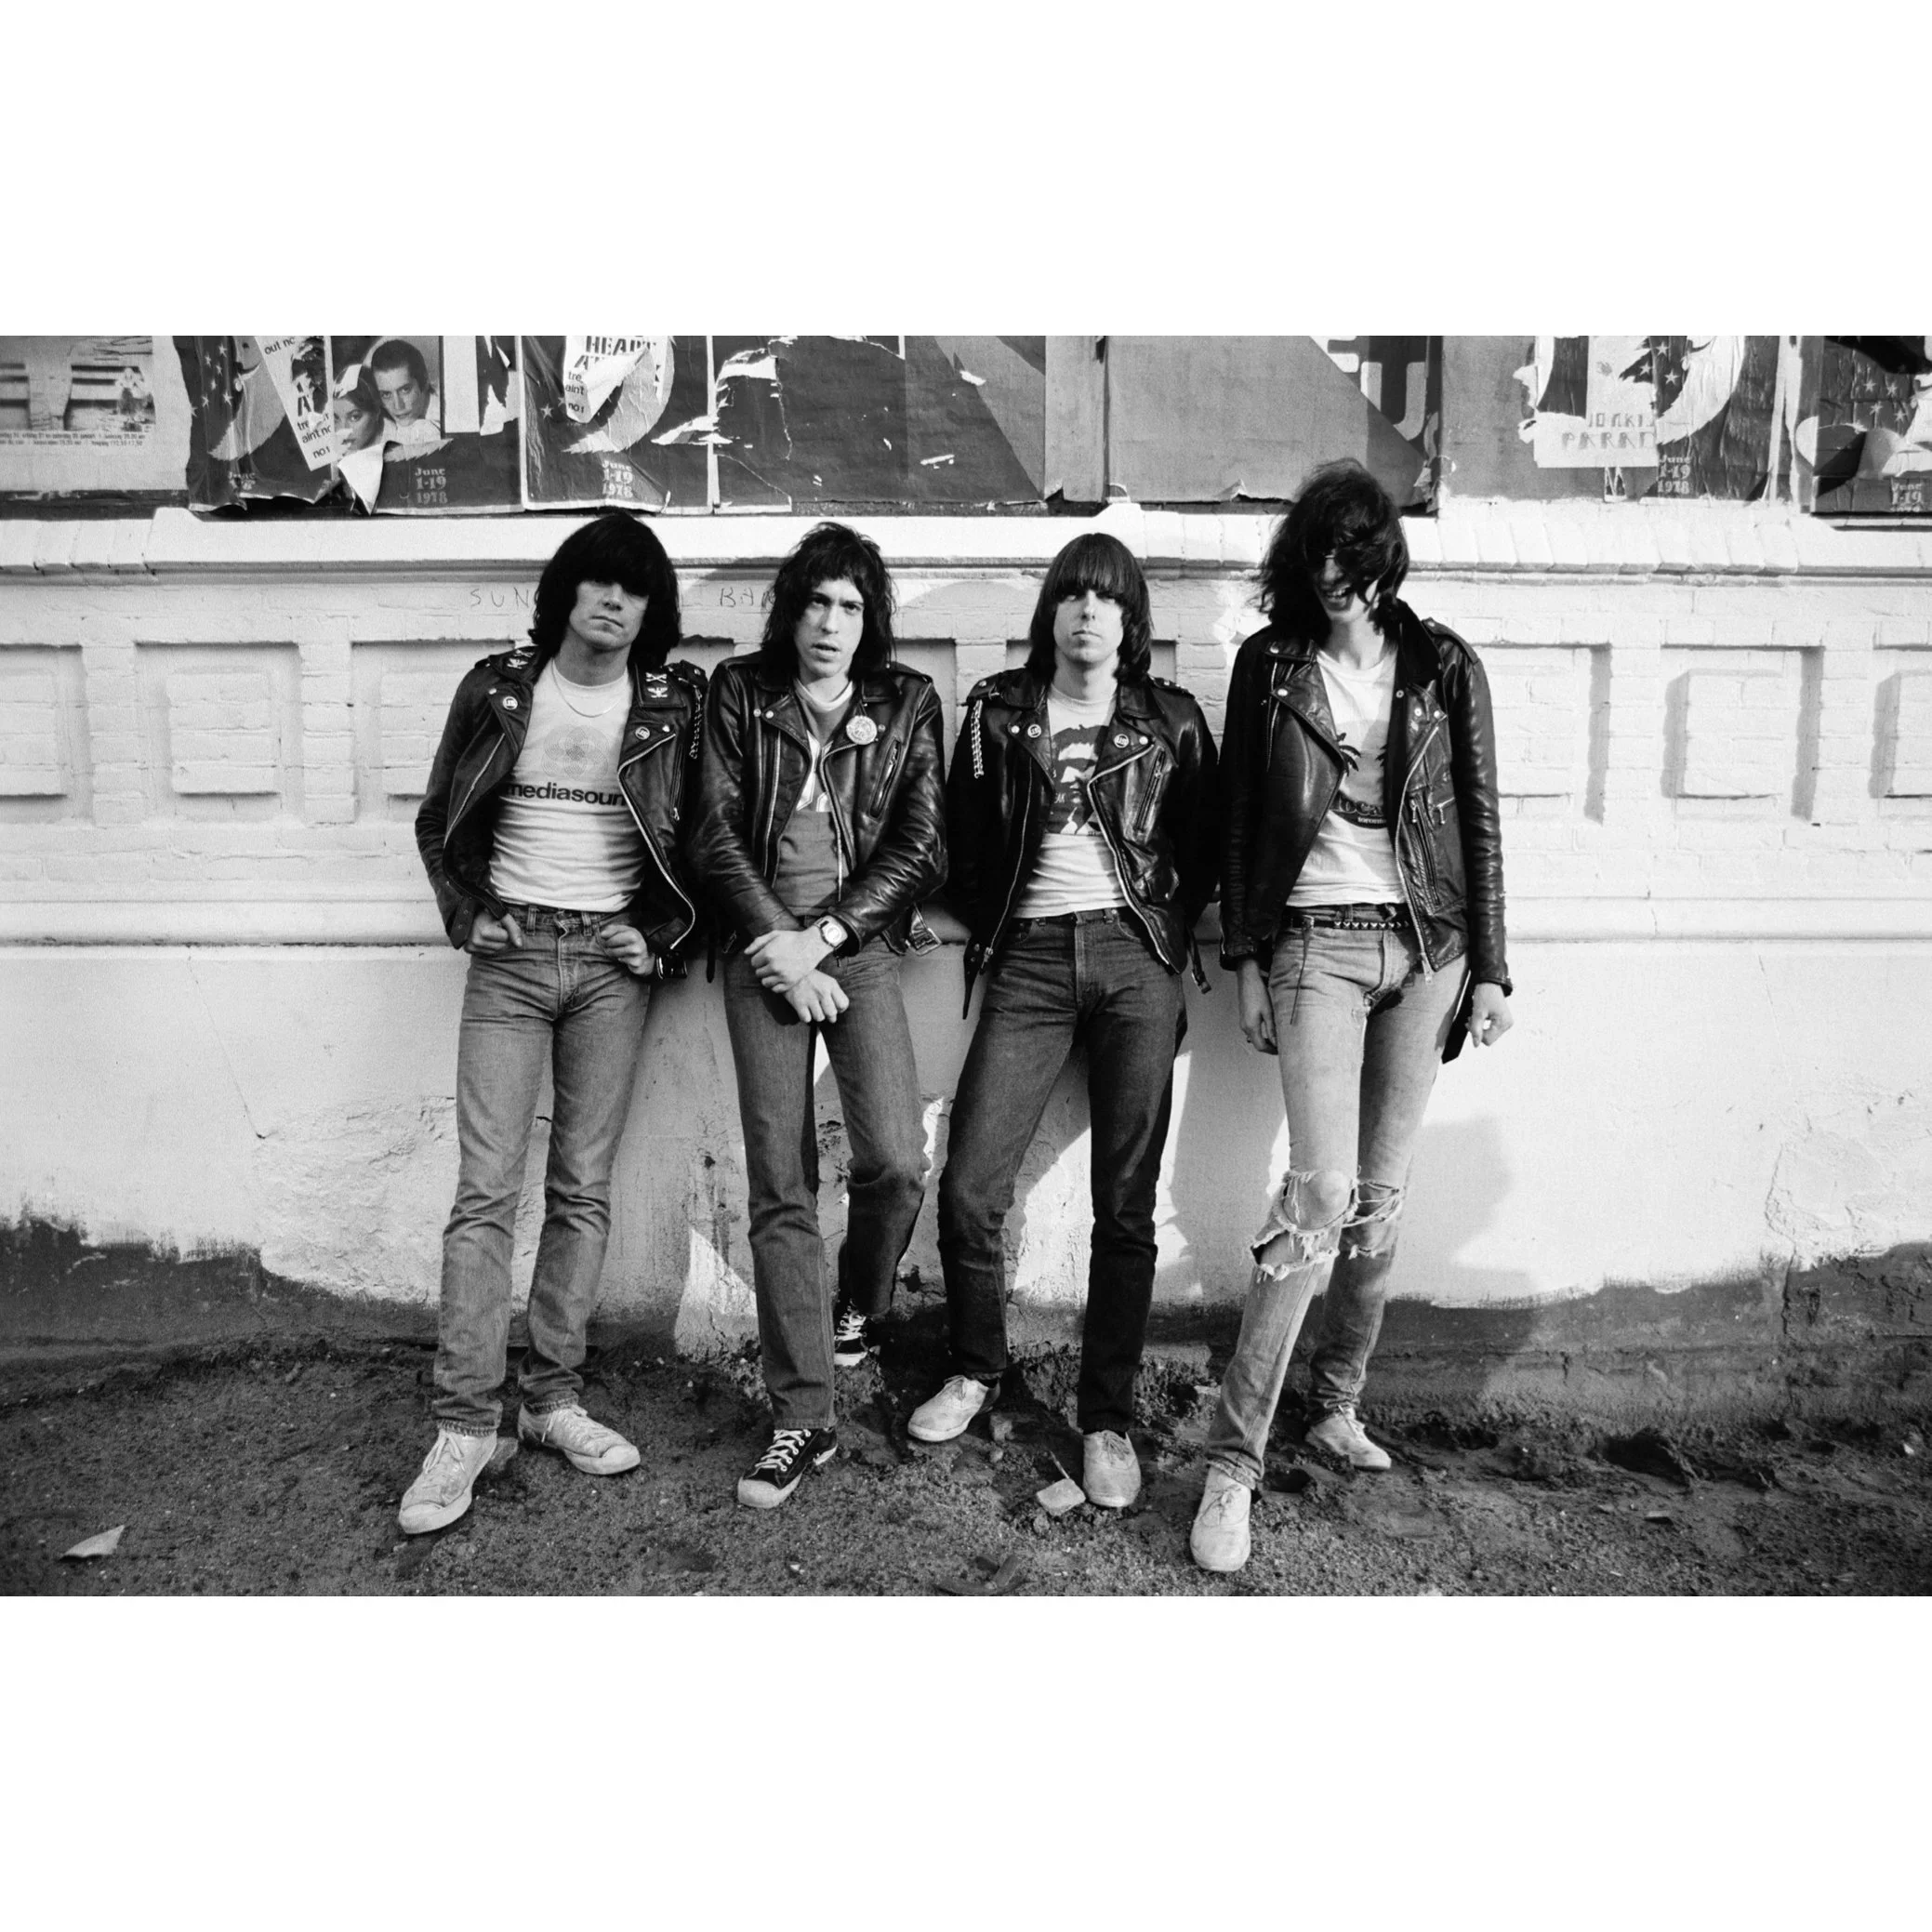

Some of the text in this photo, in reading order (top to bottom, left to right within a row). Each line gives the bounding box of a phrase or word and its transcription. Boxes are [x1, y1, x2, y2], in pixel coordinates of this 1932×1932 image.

[1659, 455, 1691, 464] June
[415, 468, 446, 476] June
[417, 476, 447, 490] 1-19
[417, 491, 448, 505] 1978
